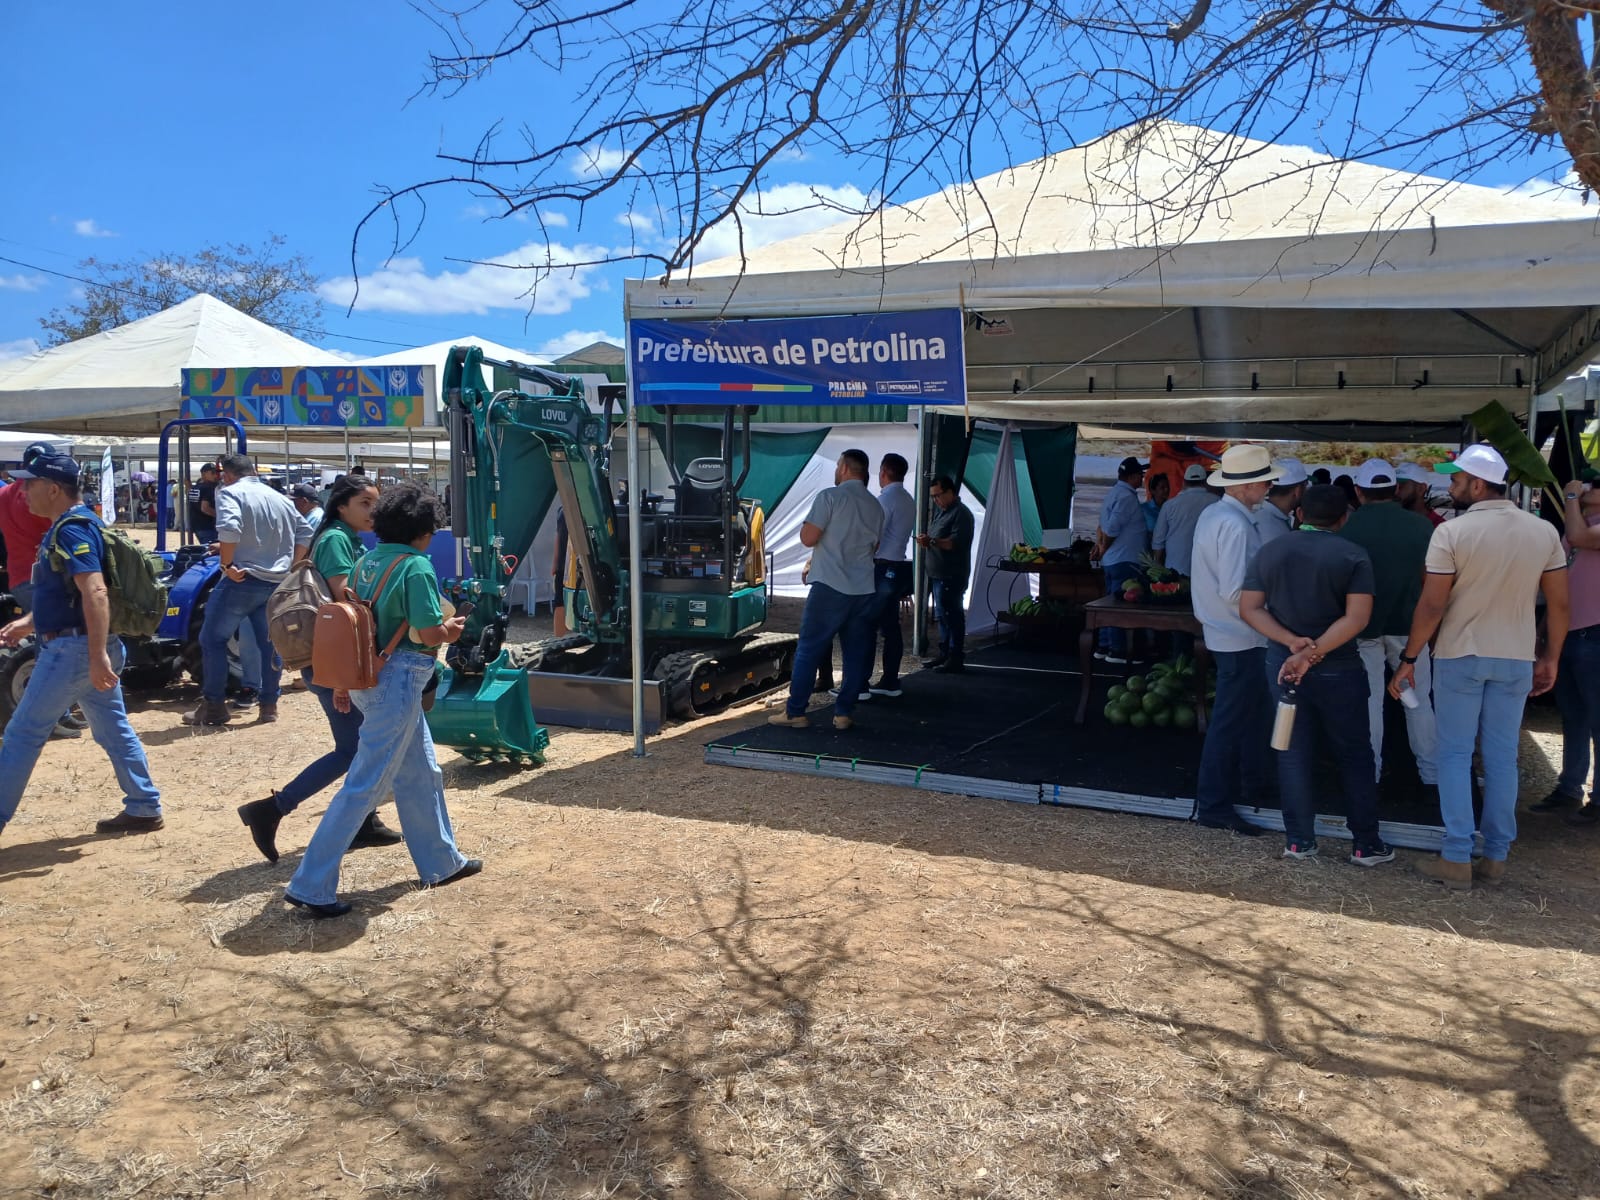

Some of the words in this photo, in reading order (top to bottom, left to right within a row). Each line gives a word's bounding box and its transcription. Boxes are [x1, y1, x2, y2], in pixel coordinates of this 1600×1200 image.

[637, 337, 768, 365] Prefeitura
[773, 338, 806, 365] de
[812, 332, 946, 365] Petrolina
[828, 381, 845, 392] PRA
[541, 408, 568, 422] LOVOL
